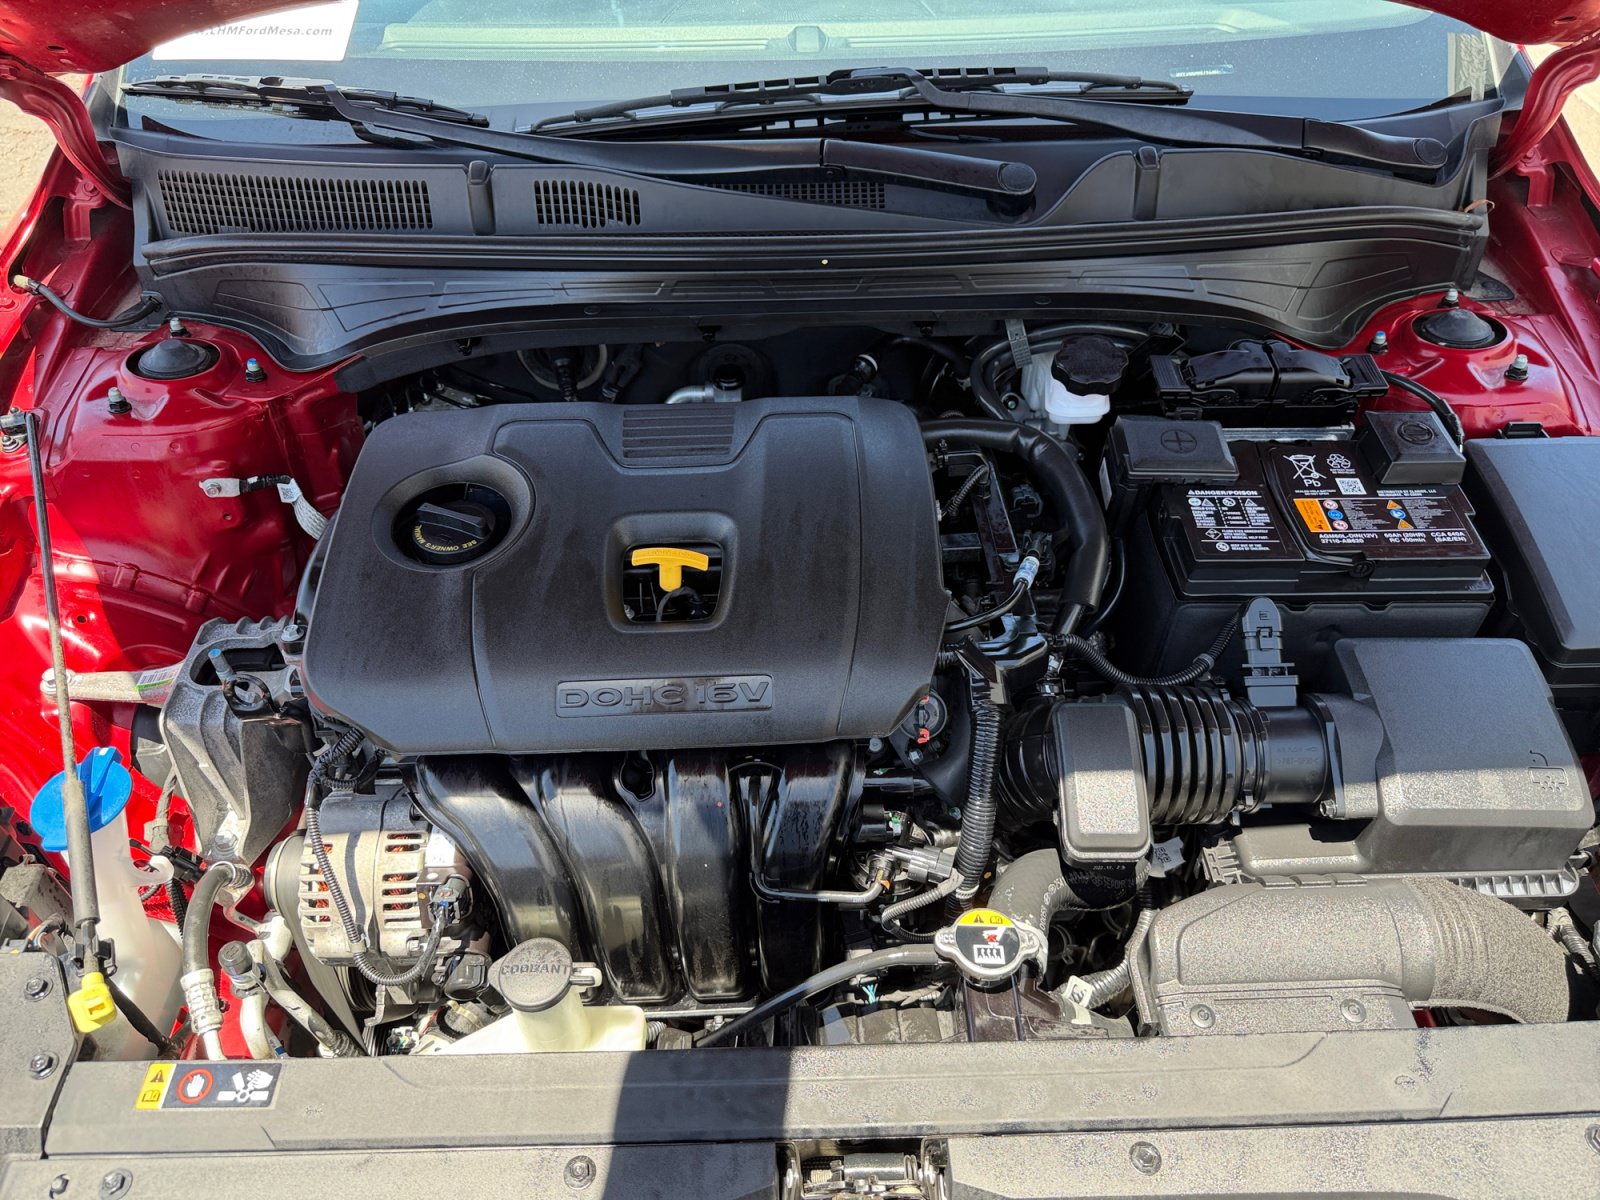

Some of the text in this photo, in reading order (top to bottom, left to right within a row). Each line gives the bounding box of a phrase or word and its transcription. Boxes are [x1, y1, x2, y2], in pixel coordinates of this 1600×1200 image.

[1304, 479, 1322, 488] Pb
[424, 542, 459, 552] OWNER'S
[462, 540, 477, 548] SEE
[560, 682, 770, 708] DOHC 16V
